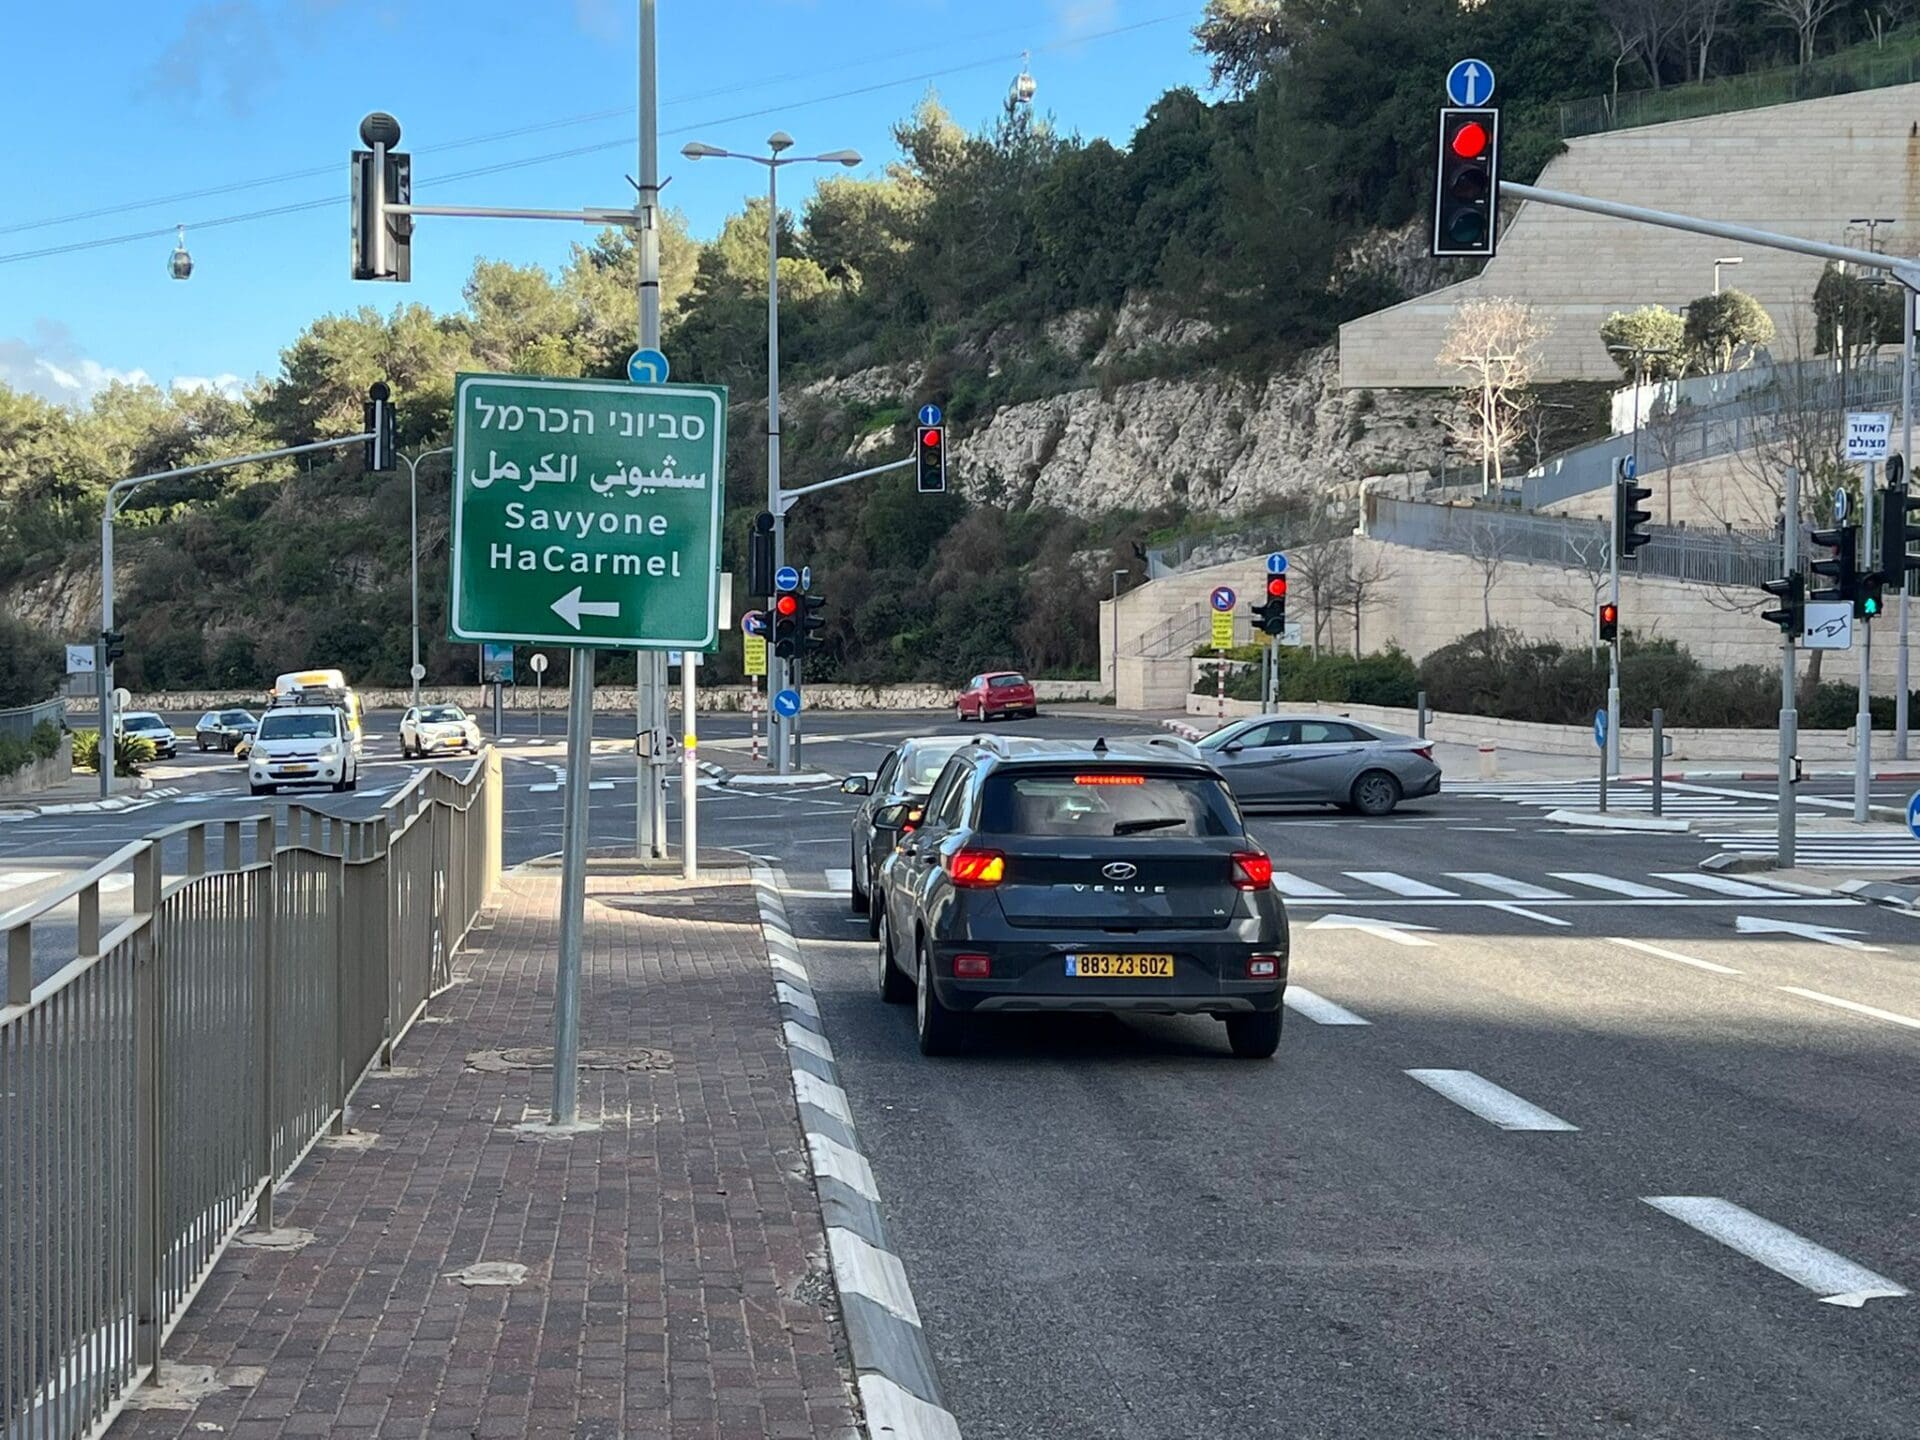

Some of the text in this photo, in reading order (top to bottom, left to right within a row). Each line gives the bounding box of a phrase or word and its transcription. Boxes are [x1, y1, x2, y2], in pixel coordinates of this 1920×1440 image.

[475, 397, 706, 440] סביוני הכרמל
[1849, 437, 1886, 447] מצולם
[471, 450, 577, 491] الكرمل
[505, 502, 668, 539] Savyone
[490, 543, 681, 577] HaCarmel
[1073, 884, 1166, 893] VENUE
